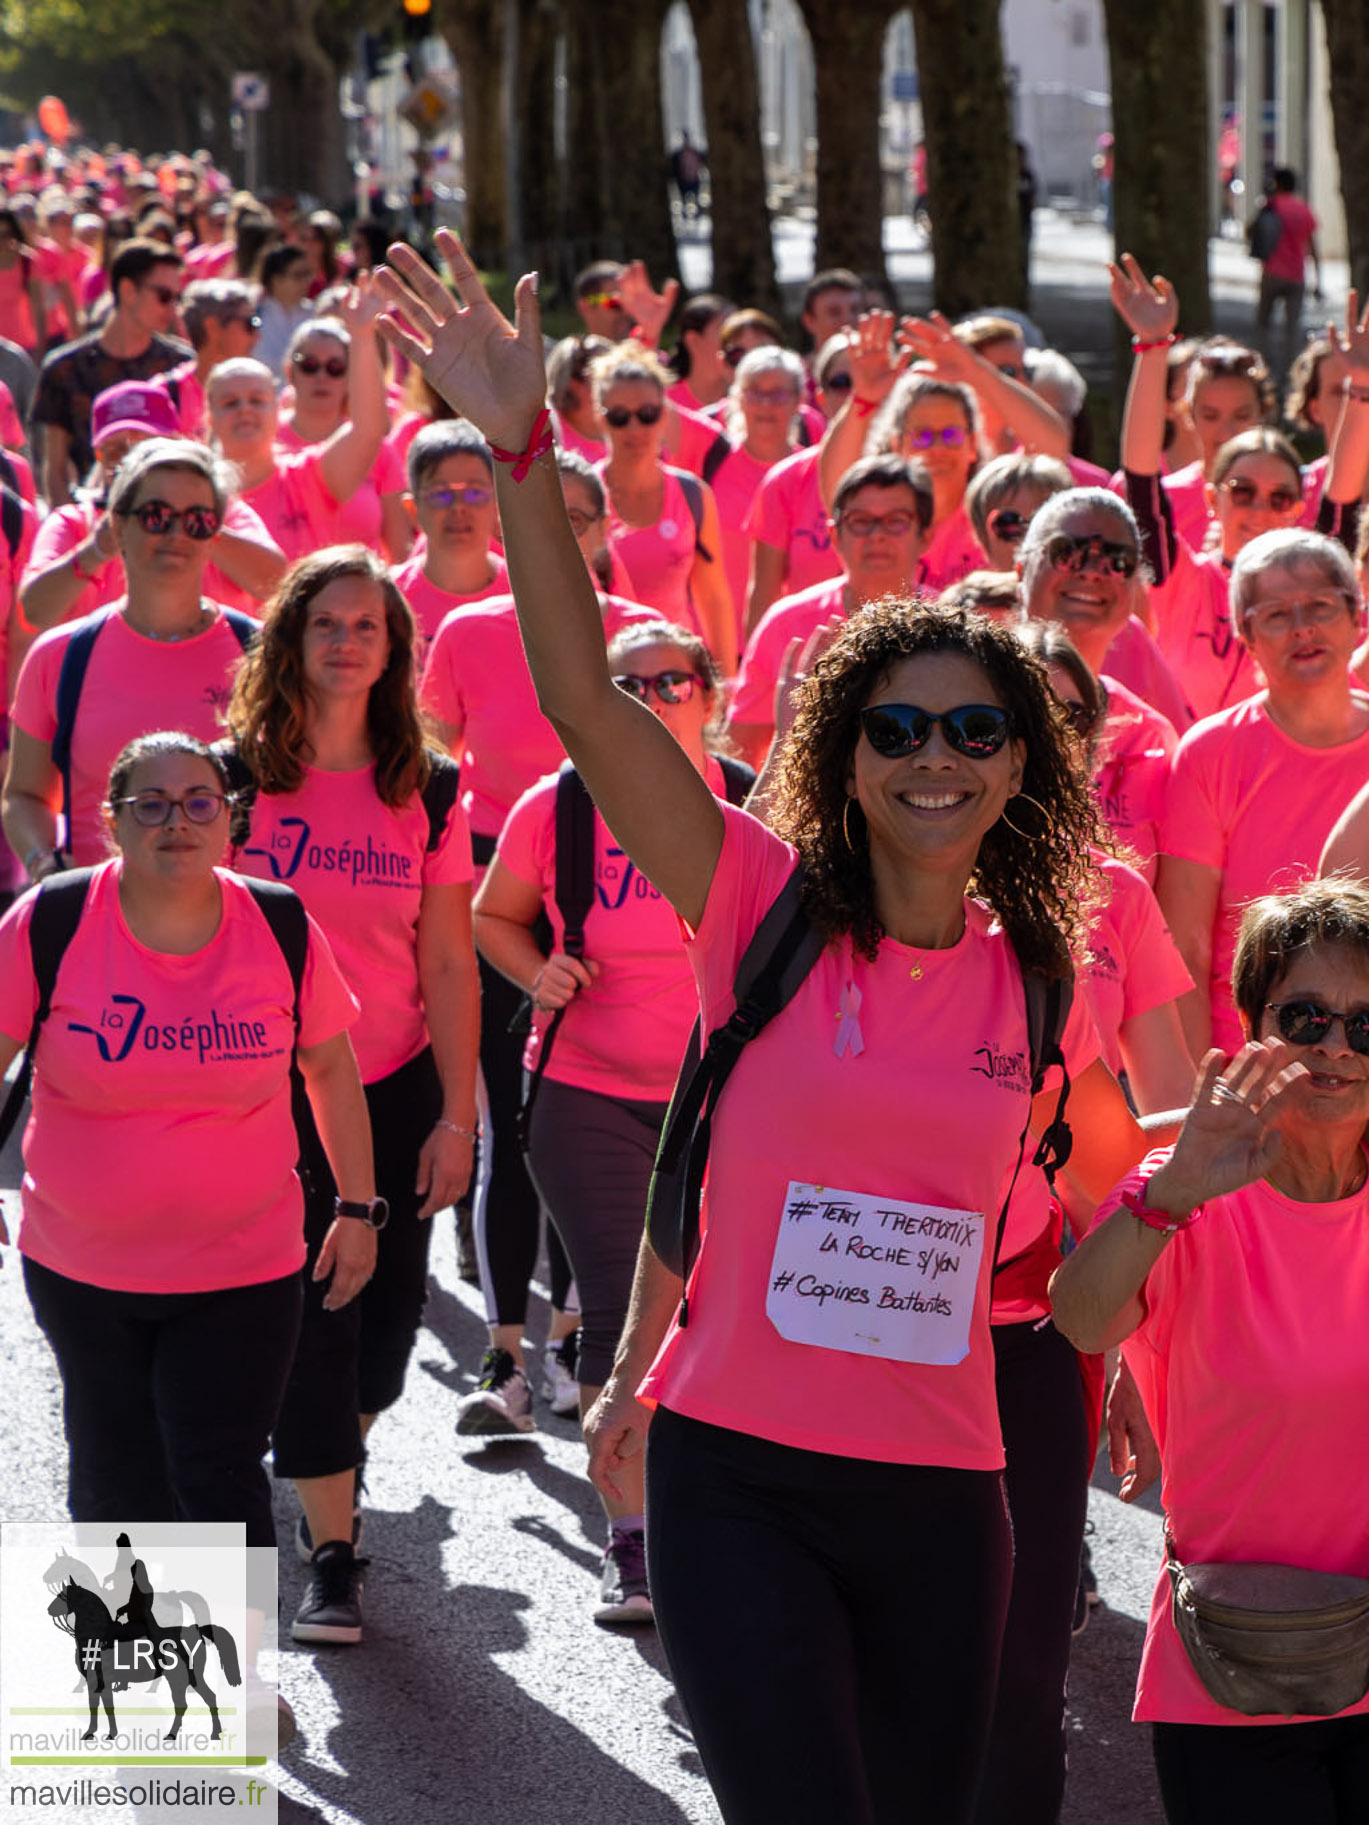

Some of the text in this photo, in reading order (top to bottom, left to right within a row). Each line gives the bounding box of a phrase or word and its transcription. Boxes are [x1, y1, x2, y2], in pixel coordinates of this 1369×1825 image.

[243, 817, 413, 886] Joséphine
[67, 994, 268, 1064] la Joséphine
[819, 1231, 838, 1252] LA
[845, 1234, 913, 1266] ROCHE
